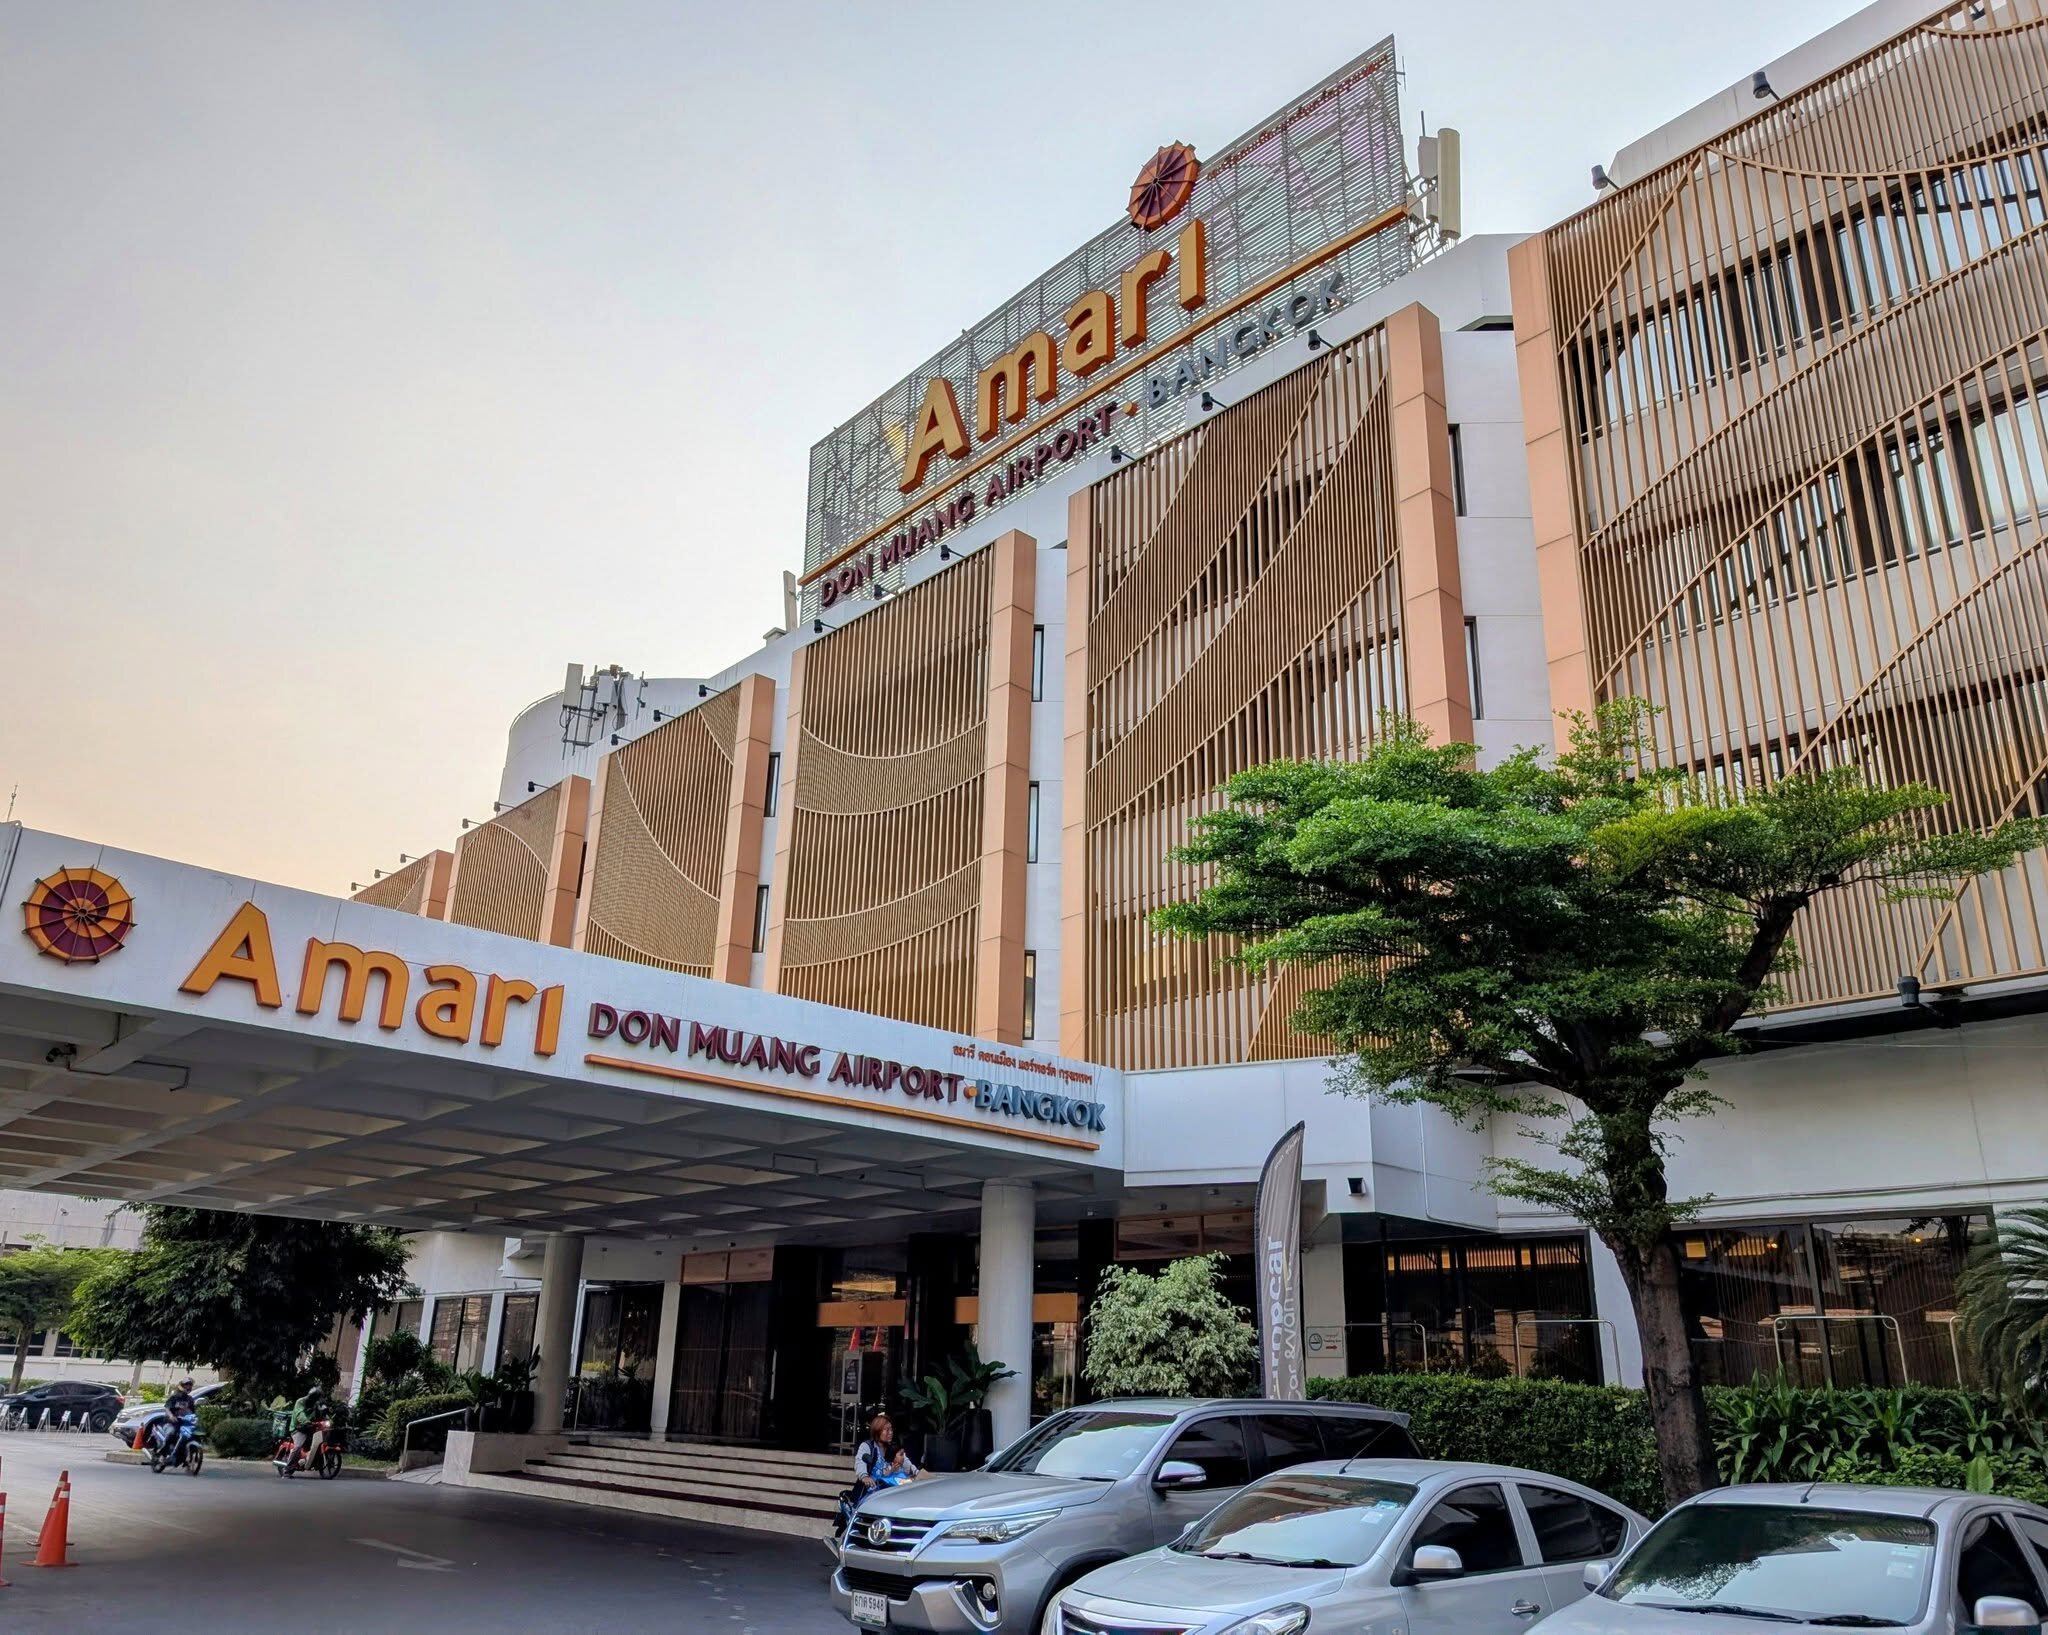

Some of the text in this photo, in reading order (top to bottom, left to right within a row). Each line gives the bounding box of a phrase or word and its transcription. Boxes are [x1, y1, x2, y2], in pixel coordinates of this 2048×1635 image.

[821, 272, 1347, 607] DON MUANG AIRPORT BANGKOK
[900, 218, 1206, 494] Amari
[178, 901, 565, 1057] Amari
[588, 1002, 1105, 1132] DON MUANG AIRPORT BANGKOK
